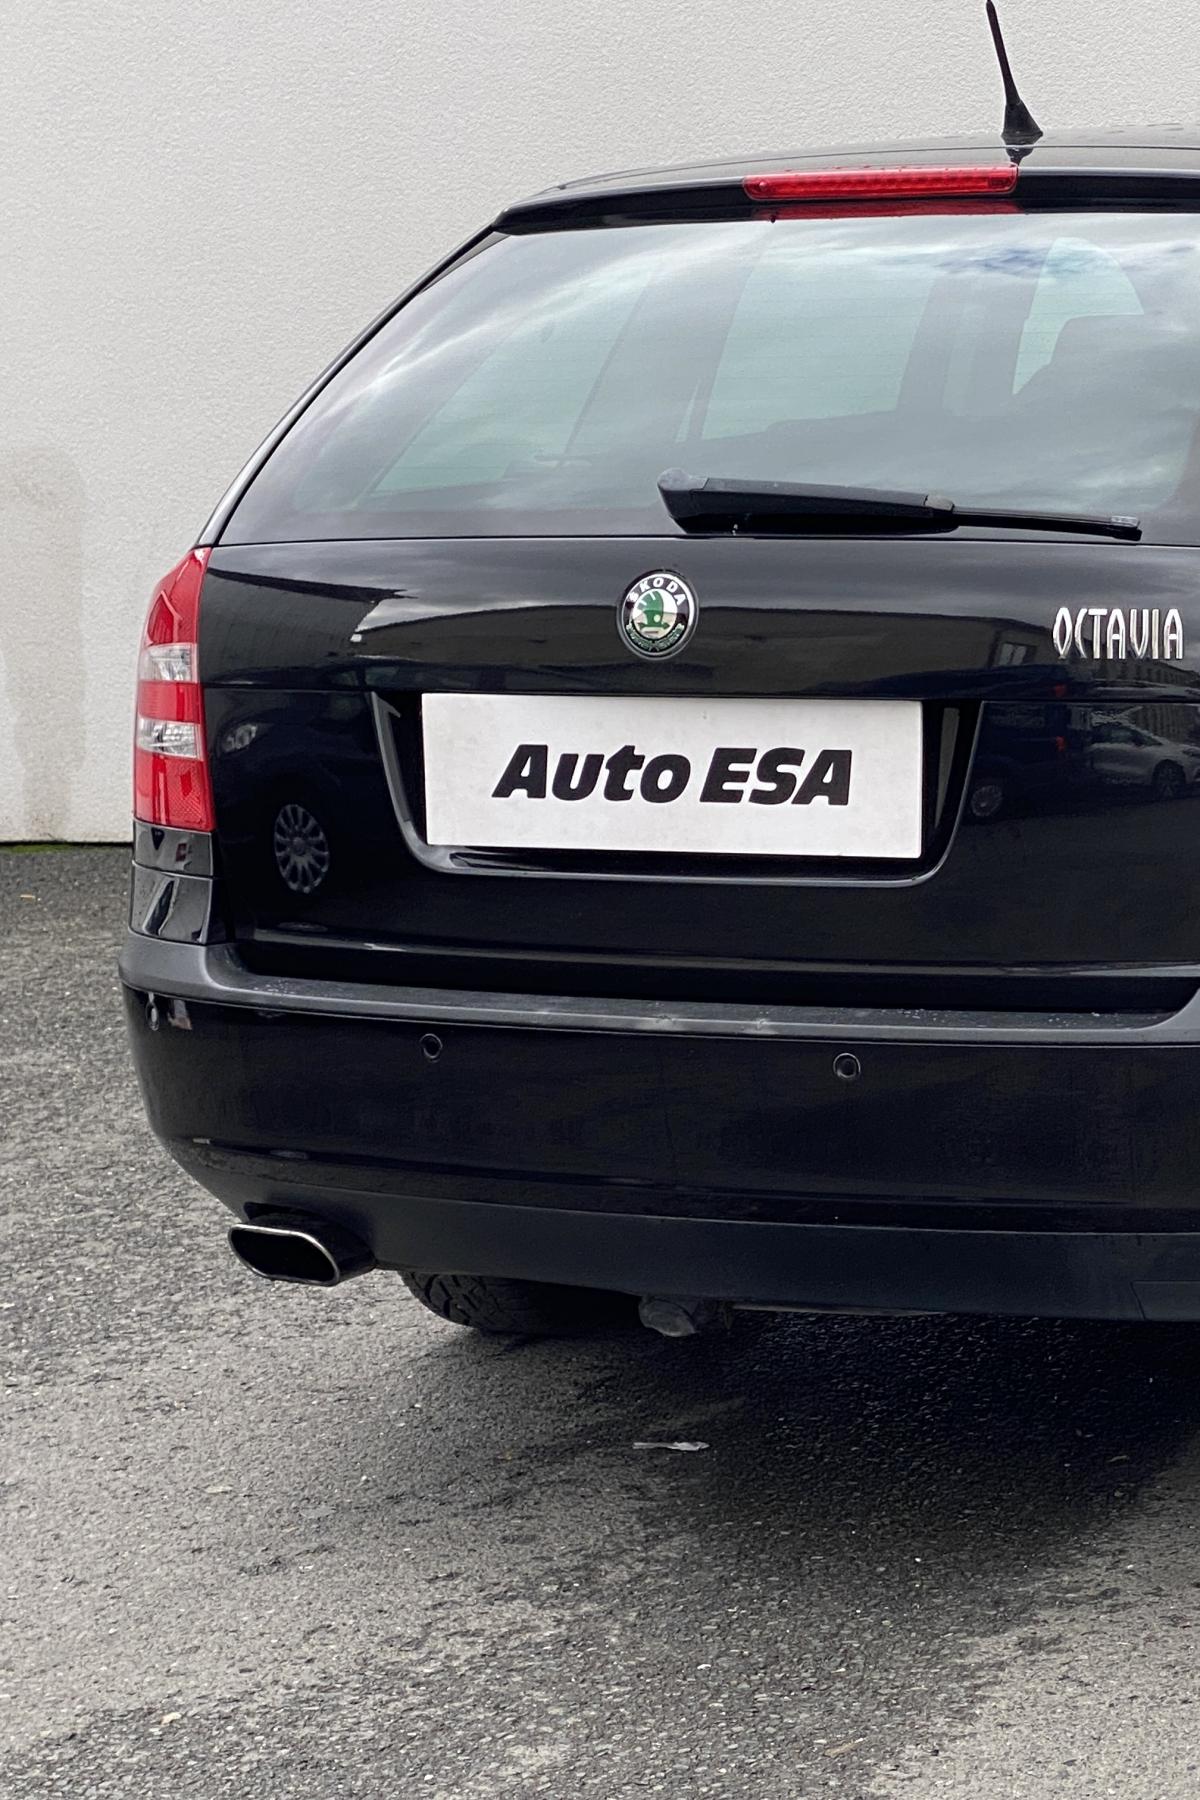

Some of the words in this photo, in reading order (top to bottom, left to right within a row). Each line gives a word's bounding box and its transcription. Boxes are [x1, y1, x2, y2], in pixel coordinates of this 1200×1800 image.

[1052, 606, 1184, 660] OCTAVIA
[491, 744, 691, 804] Auto
[699, 747, 853, 806] ESA
